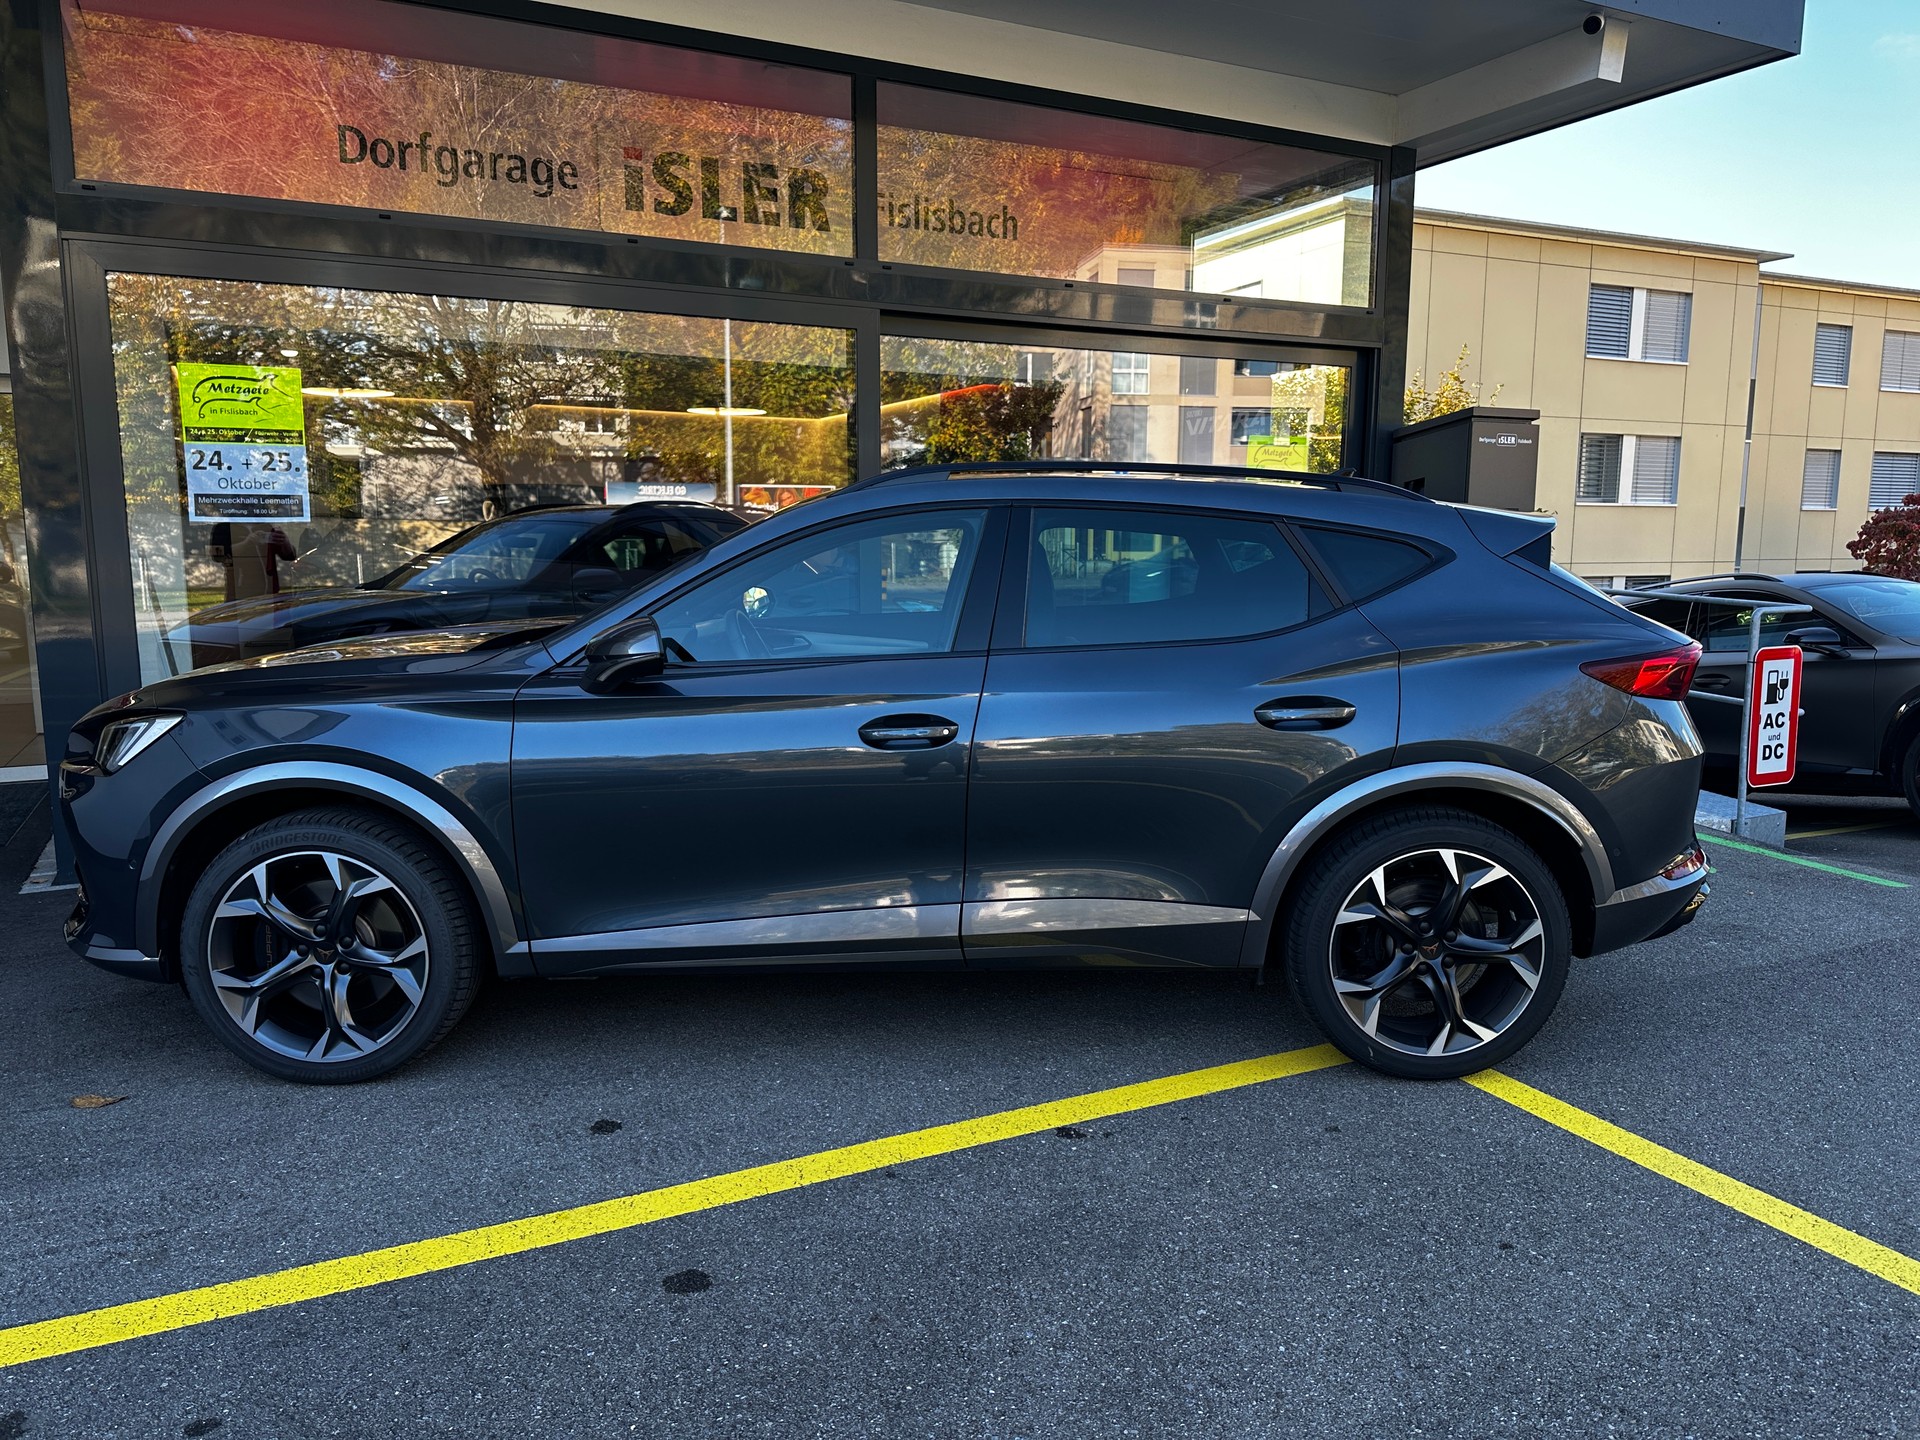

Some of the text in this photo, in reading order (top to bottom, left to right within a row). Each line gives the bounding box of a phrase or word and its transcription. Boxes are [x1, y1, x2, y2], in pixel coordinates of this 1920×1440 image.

[337, 123, 579, 198] Dorfgarage
[622, 146, 831, 232] iSLER
[210, 407, 258, 416] in Fislisbach
[191, 449, 233, 471] 24.
[261, 452, 301, 473] 25.
[217, 477, 277, 490] Oktober
[198, 496, 259, 504] Mehrzweckhalle
[1763, 712, 1785, 729] AC
[1768, 733, 1781, 741] und
[1762, 743, 1784, 760] DC
[249, 831, 345, 855] BRIDGESTONE
